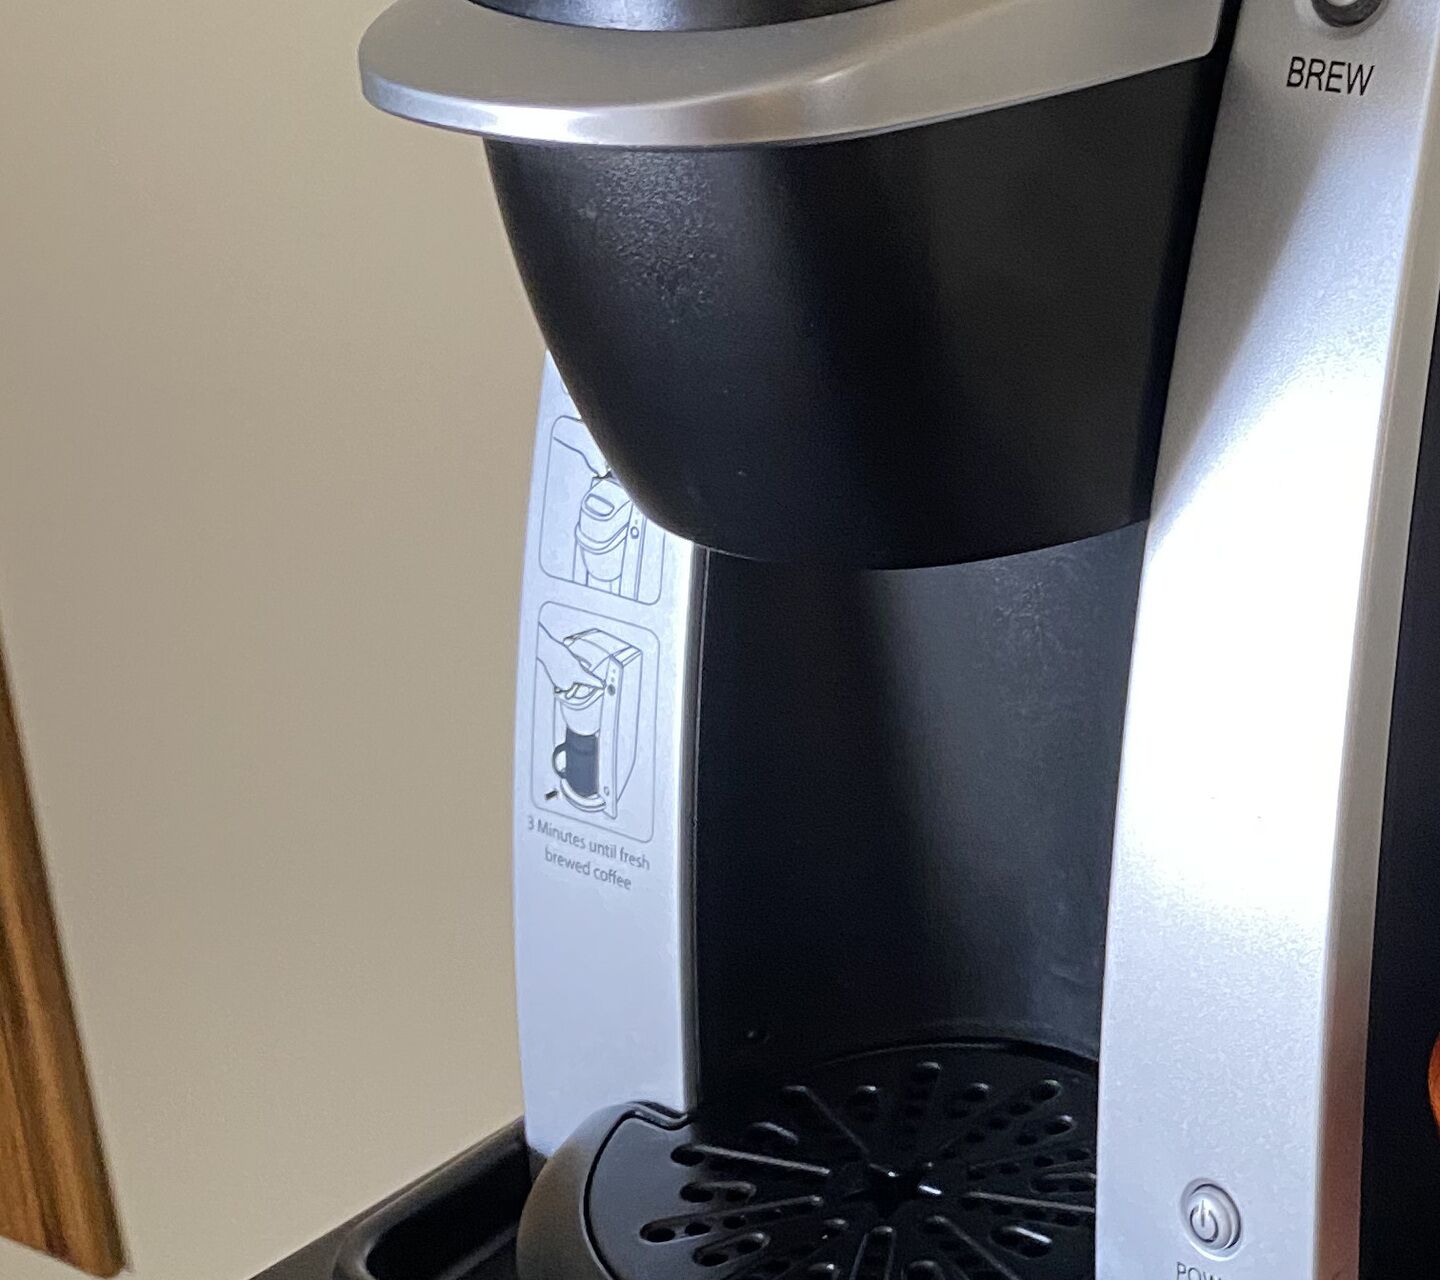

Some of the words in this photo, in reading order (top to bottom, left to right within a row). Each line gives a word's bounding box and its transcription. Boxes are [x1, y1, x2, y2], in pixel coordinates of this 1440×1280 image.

[1286, 56, 1375, 96] BREW
[528, 815, 535, 831] 3
[537, 818, 586, 850] Minutes
[589, 841, 617, 859] until
[619, 846, 651, 871] fresh
[544, 844, 591, 876] brewed
[593, 868, 632, 891] coffee
